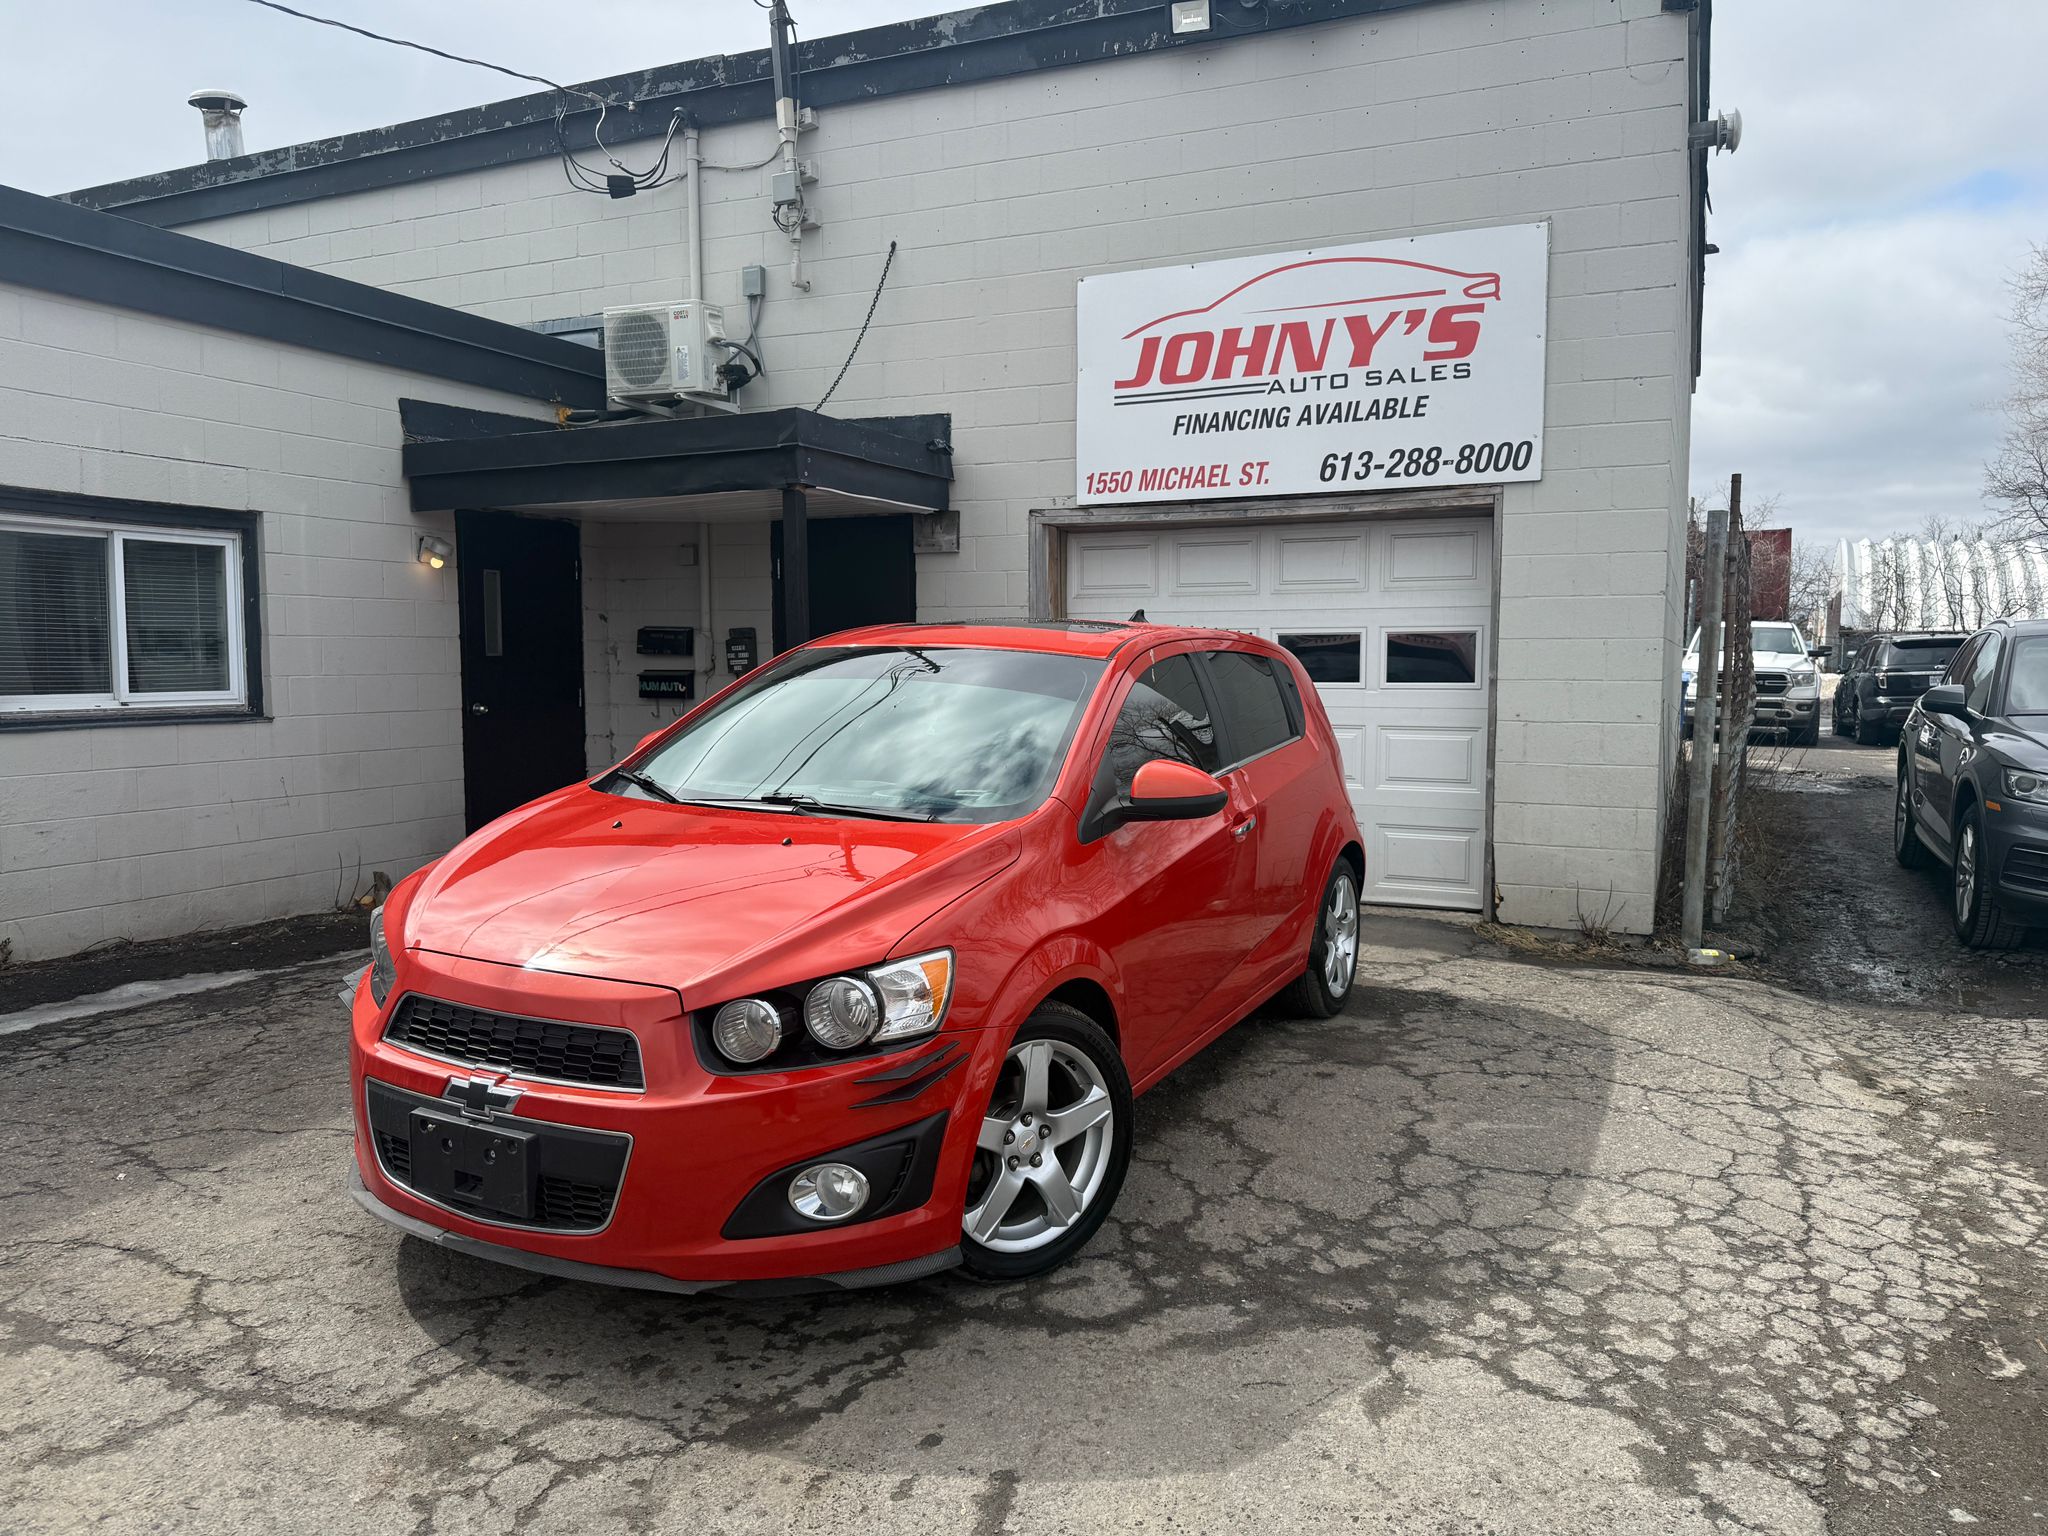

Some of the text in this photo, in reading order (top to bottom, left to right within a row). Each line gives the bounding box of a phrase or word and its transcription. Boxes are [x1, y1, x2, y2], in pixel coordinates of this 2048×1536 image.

[1267, 362, 1472, 395] AUTO SALES
[1172, 395, 1430, 436] FINANCING AVAILABLE
[1086, 461, 1270, 495] 1550 MICHAEL ST.
[1319, 440, 1533, 483] 613-288-8000
